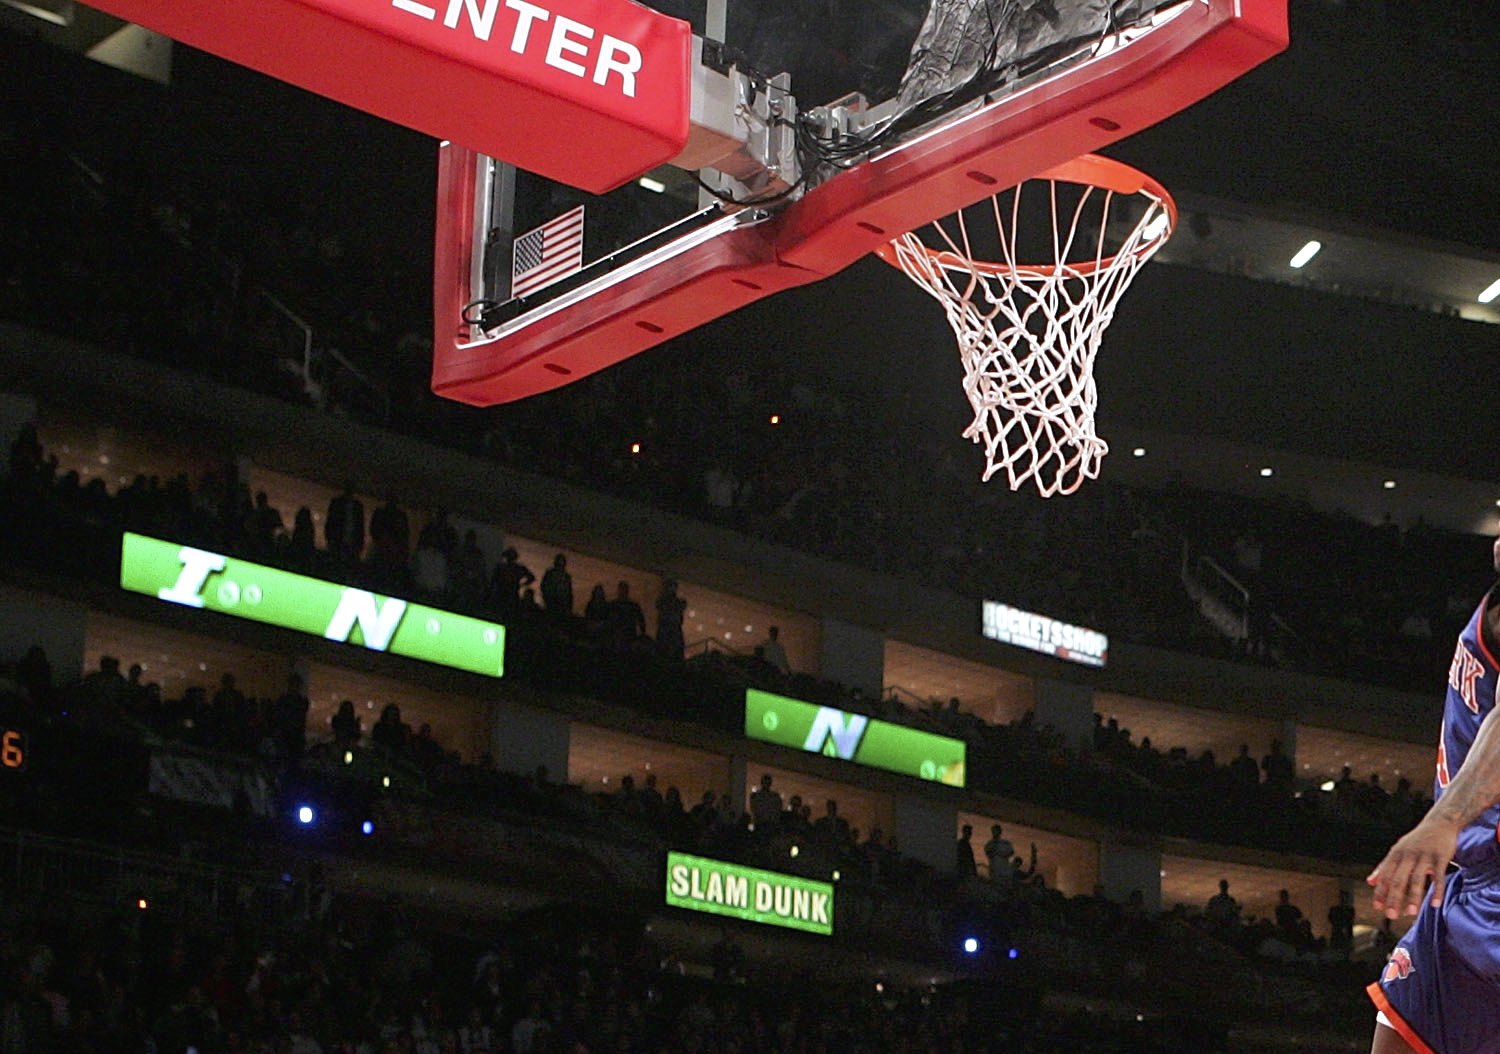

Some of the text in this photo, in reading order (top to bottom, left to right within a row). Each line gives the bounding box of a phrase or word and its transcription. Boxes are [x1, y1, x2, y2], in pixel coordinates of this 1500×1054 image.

[325, 586, 407, 652] N
[803, 705, 868, 761] N
[671, 864, 828, 925] SLAM DUNK
